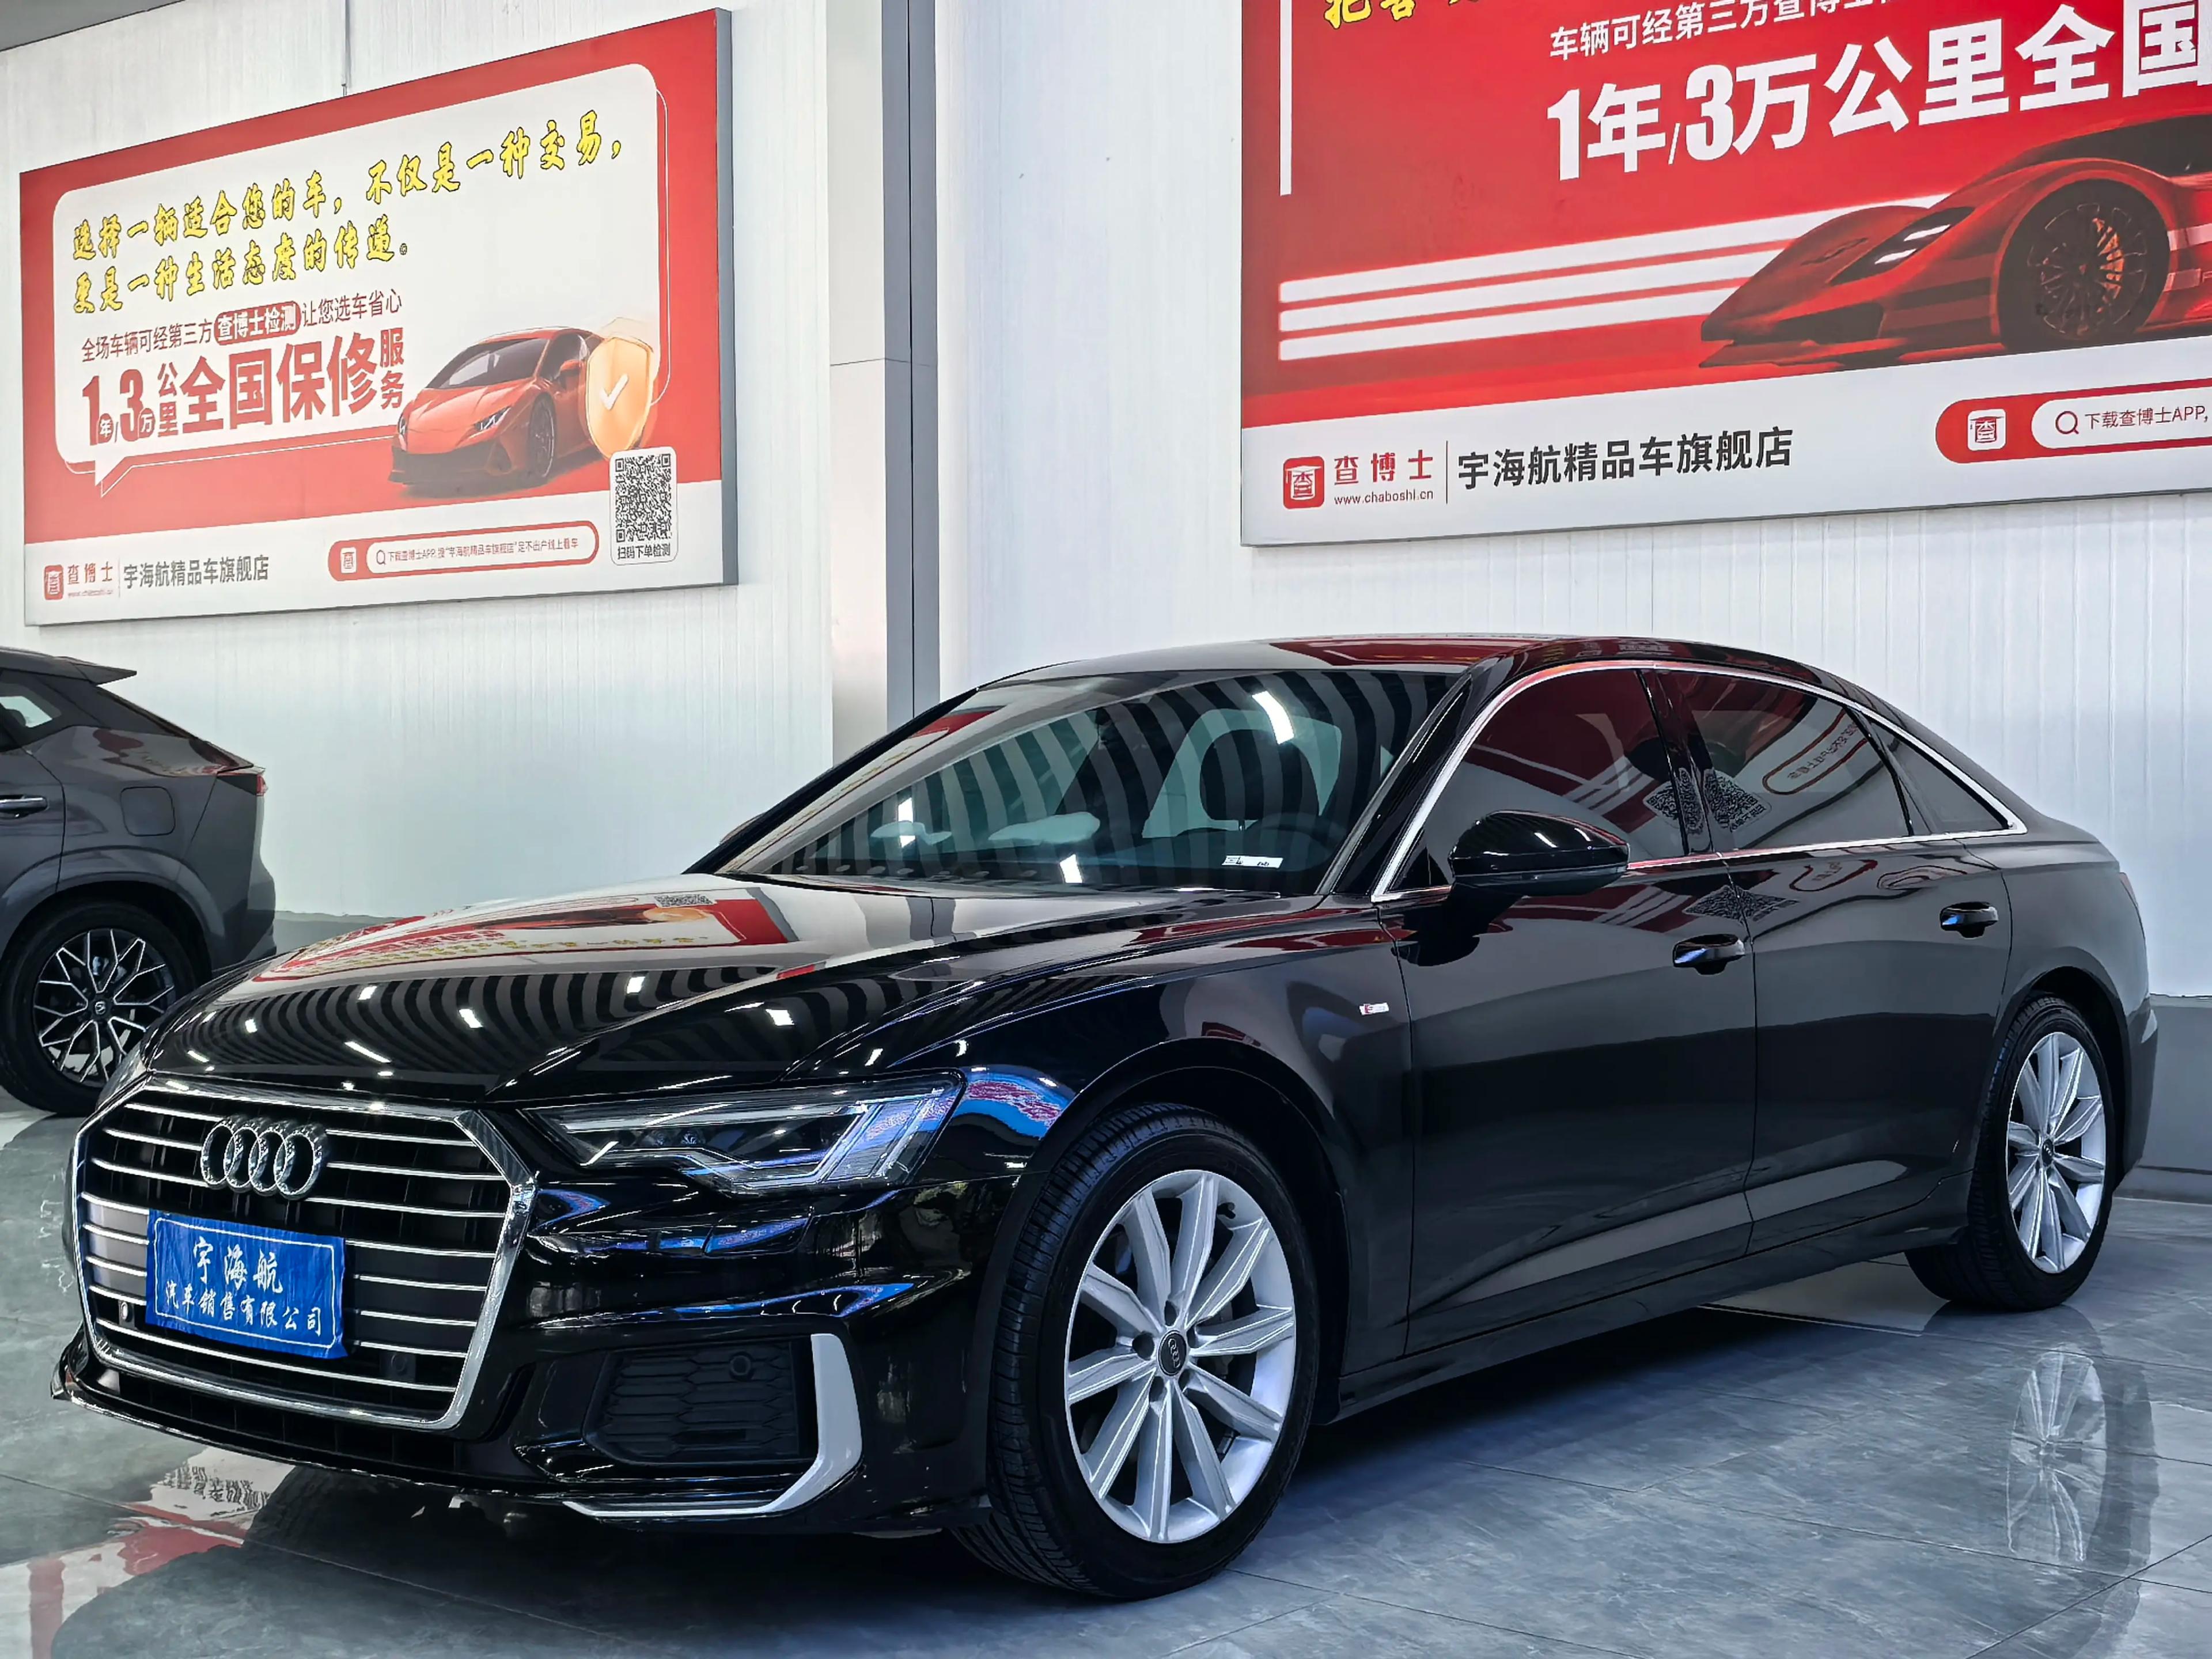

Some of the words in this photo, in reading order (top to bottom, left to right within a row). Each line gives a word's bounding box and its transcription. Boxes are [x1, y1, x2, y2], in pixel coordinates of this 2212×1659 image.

[1550, 0, 1891, 60] 车辆可经第三方查
[1334, 449, 1433, 485] 查博士
[1457, 426, 1793, 491] 宇海航精品车旗舰店
[1334, 488, 1433, 505] www.chaboshi.cn
[618, 542, 671, 560] 扫码下单检测
[123, 554, 270, 589] 宇海航精品车旗舰店
[193, 1236, 283, 1294] 宇海航
